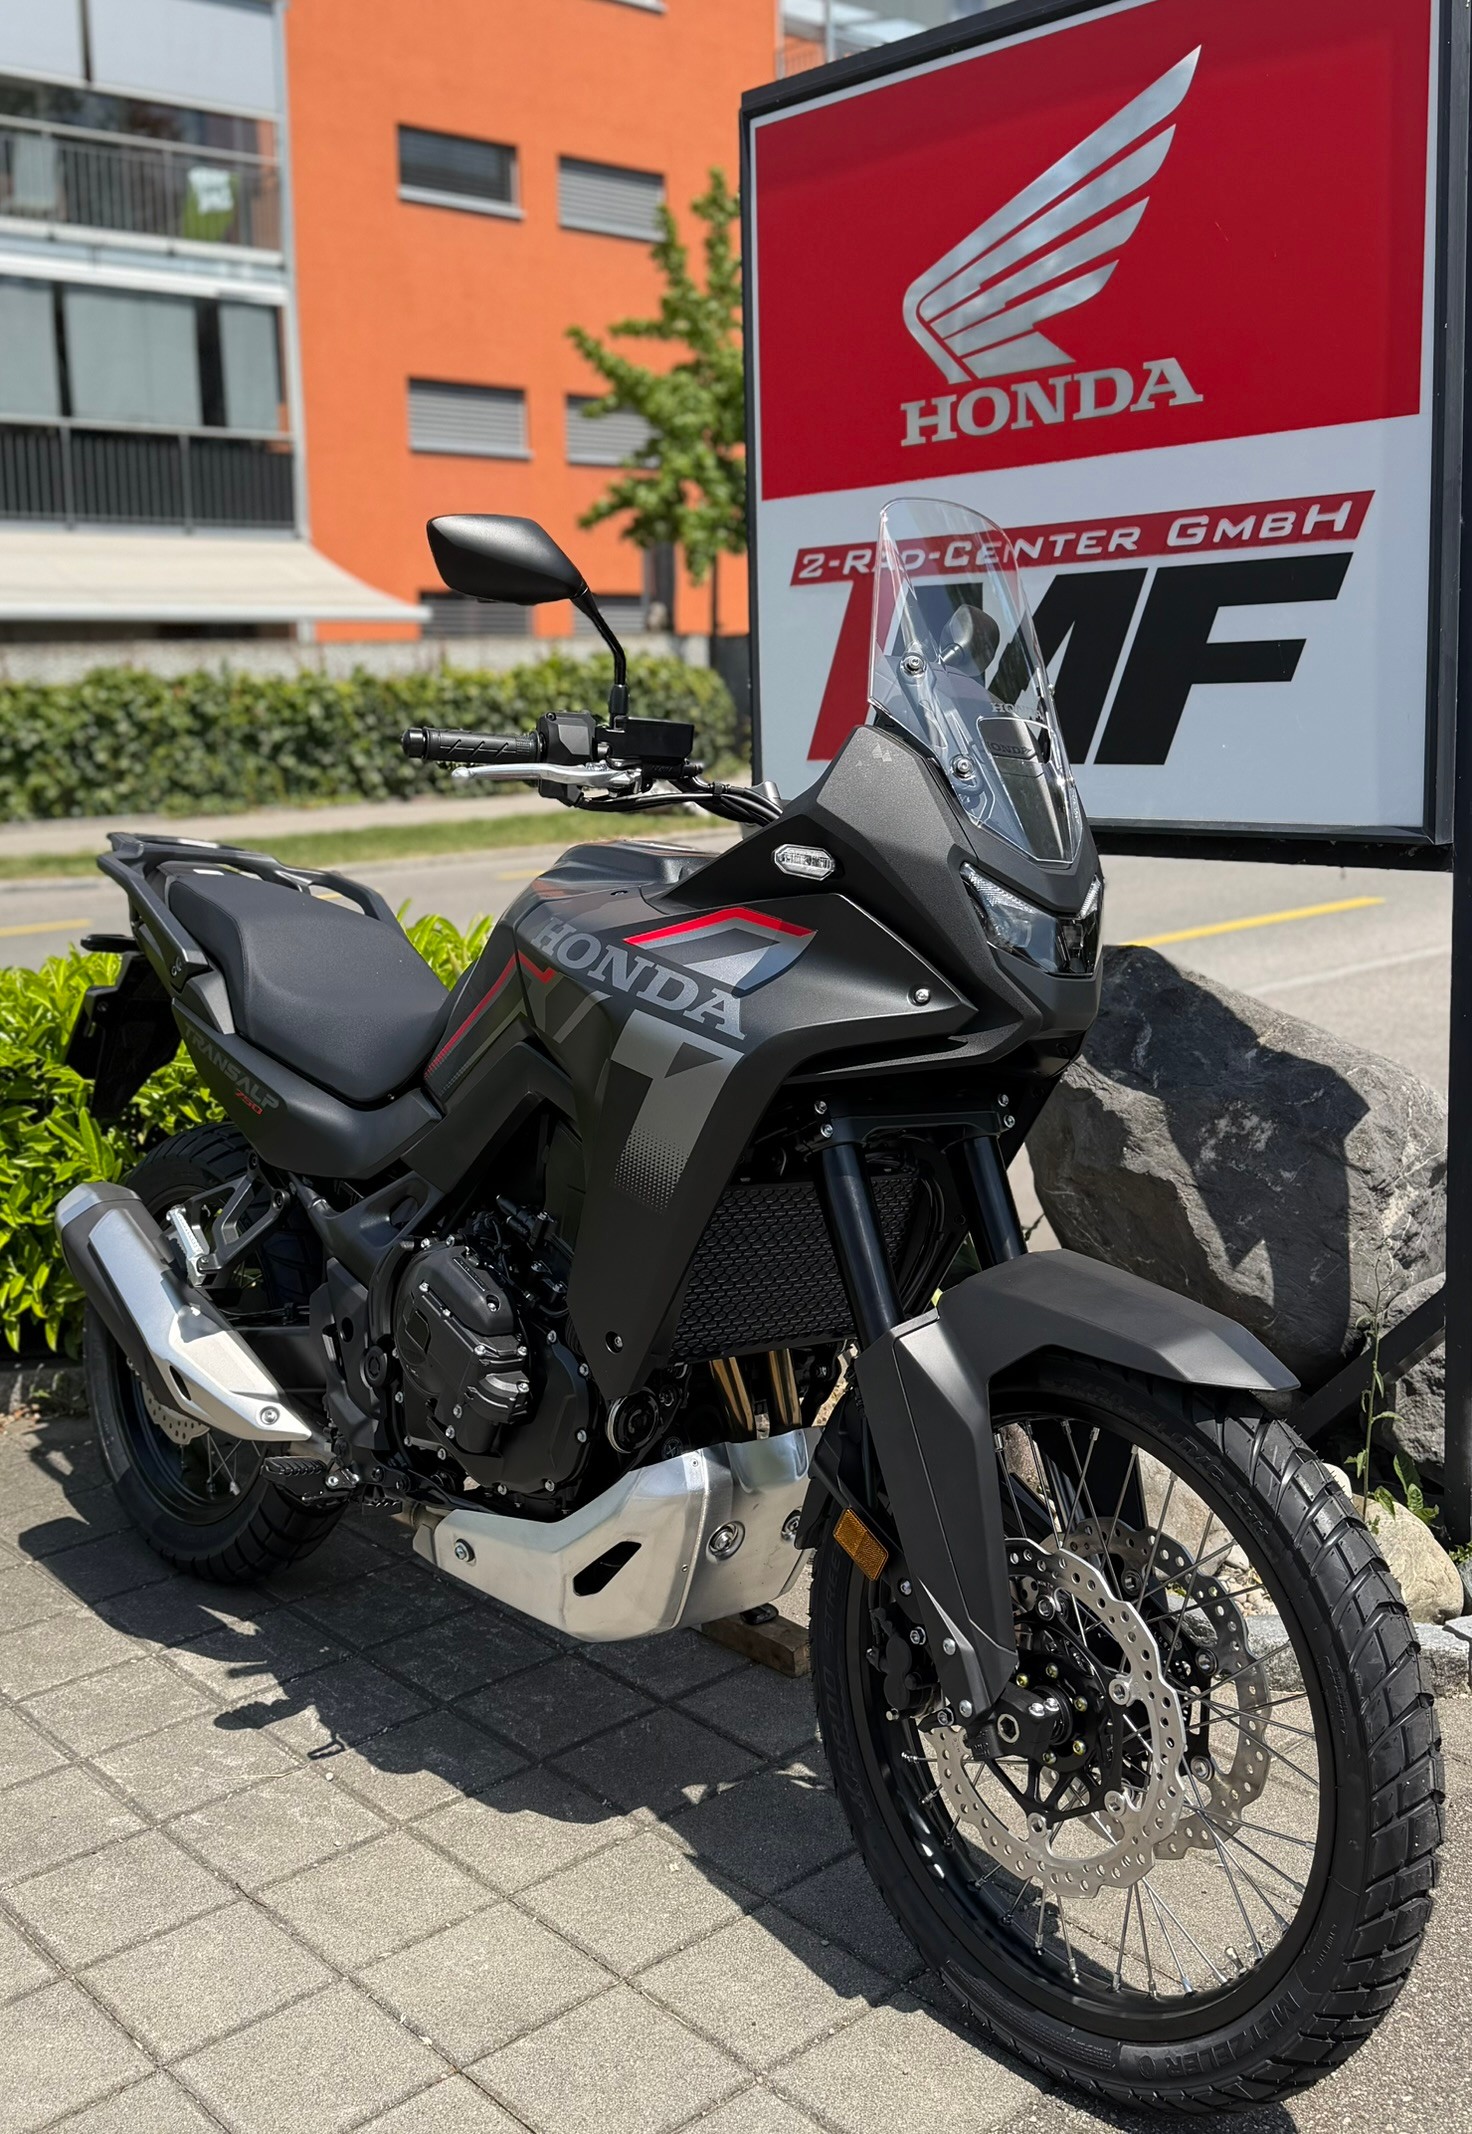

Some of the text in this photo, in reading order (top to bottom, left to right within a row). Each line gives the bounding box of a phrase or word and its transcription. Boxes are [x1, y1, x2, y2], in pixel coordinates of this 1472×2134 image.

[901, 358, 1203, 446] HONDA
[531, 917, 746, 1040] HONDA
[185, 1022, 280, 1109] TRANSALP
[235, 1089, 264, 1116] 750
[823, 1548, 843, 1646] STREE
[1166, 1990, 1300, 2078] METZELER
